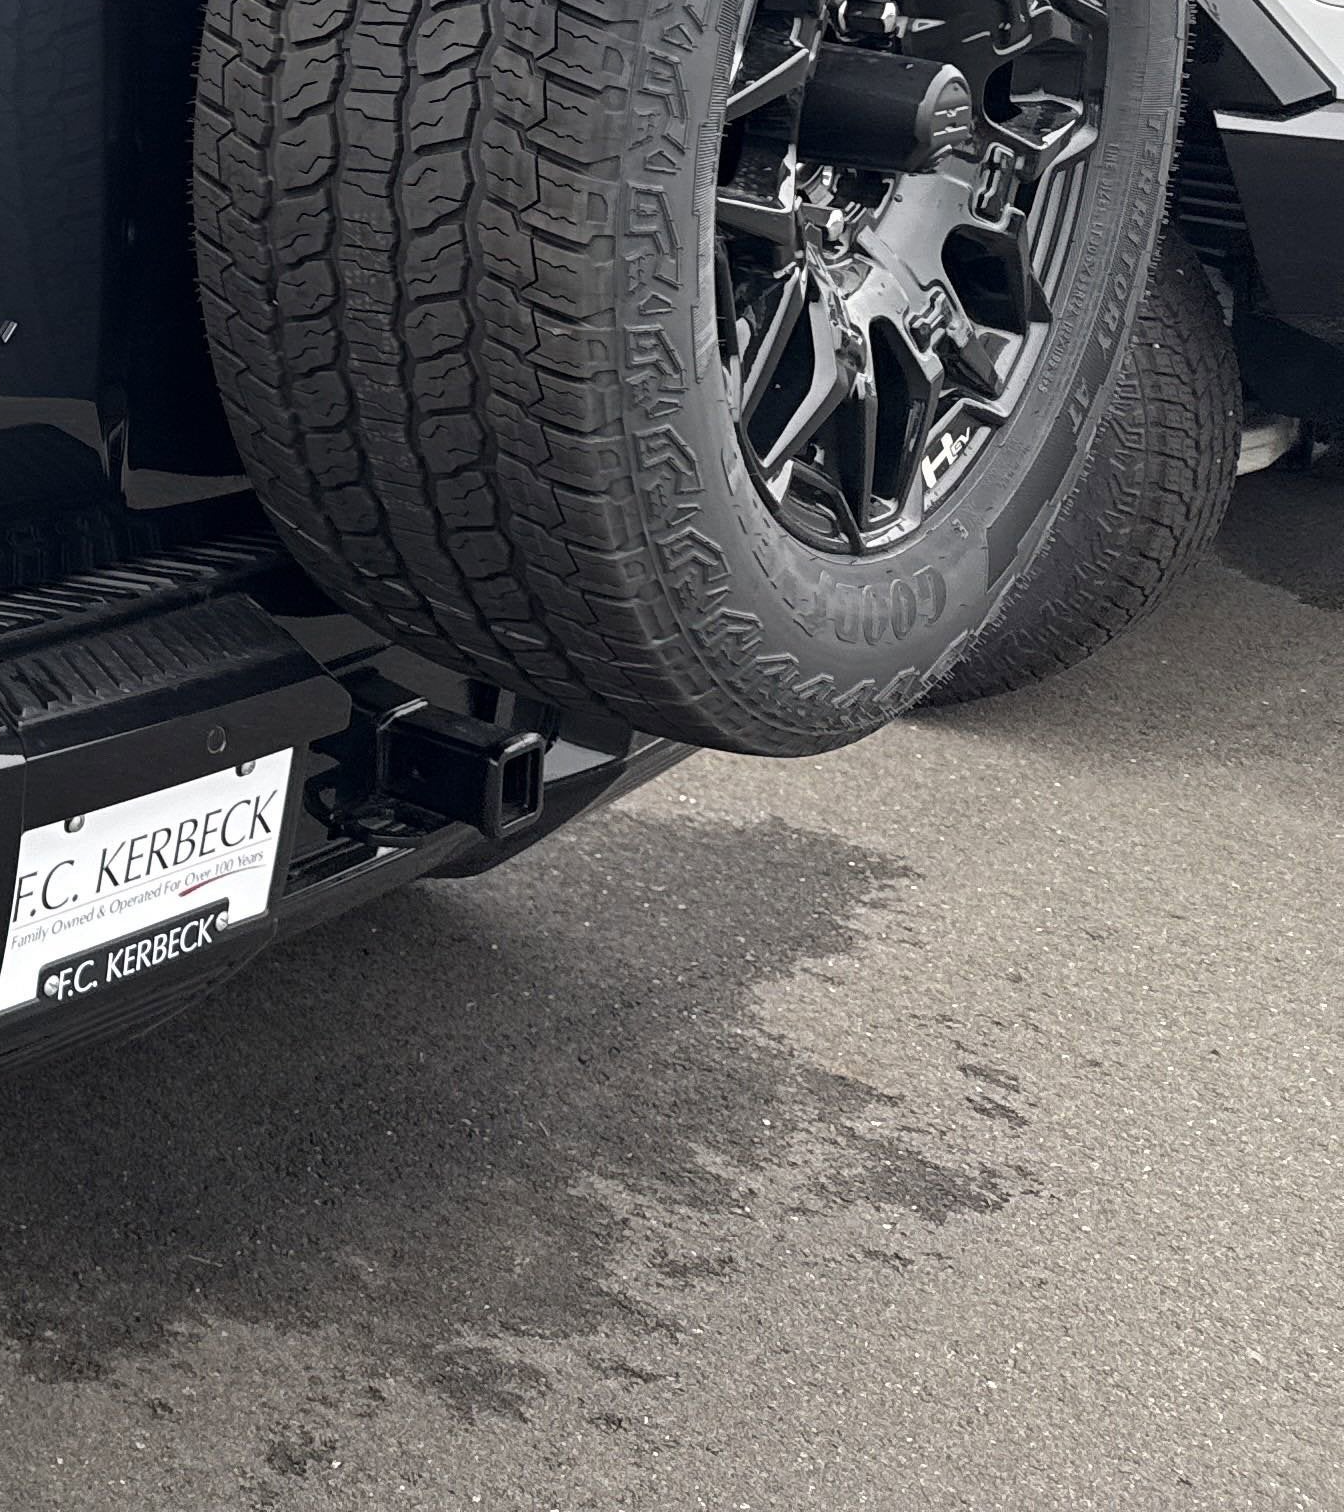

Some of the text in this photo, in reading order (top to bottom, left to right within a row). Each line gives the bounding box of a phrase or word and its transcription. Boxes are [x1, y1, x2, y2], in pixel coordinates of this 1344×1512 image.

[11, 849, 264, 949] Family Owned & Operated For Over 100 Years
[12, 790, 278, 923] F.C. KERBECK
[57, 914, 214, 1001] F.C. KERBECK
